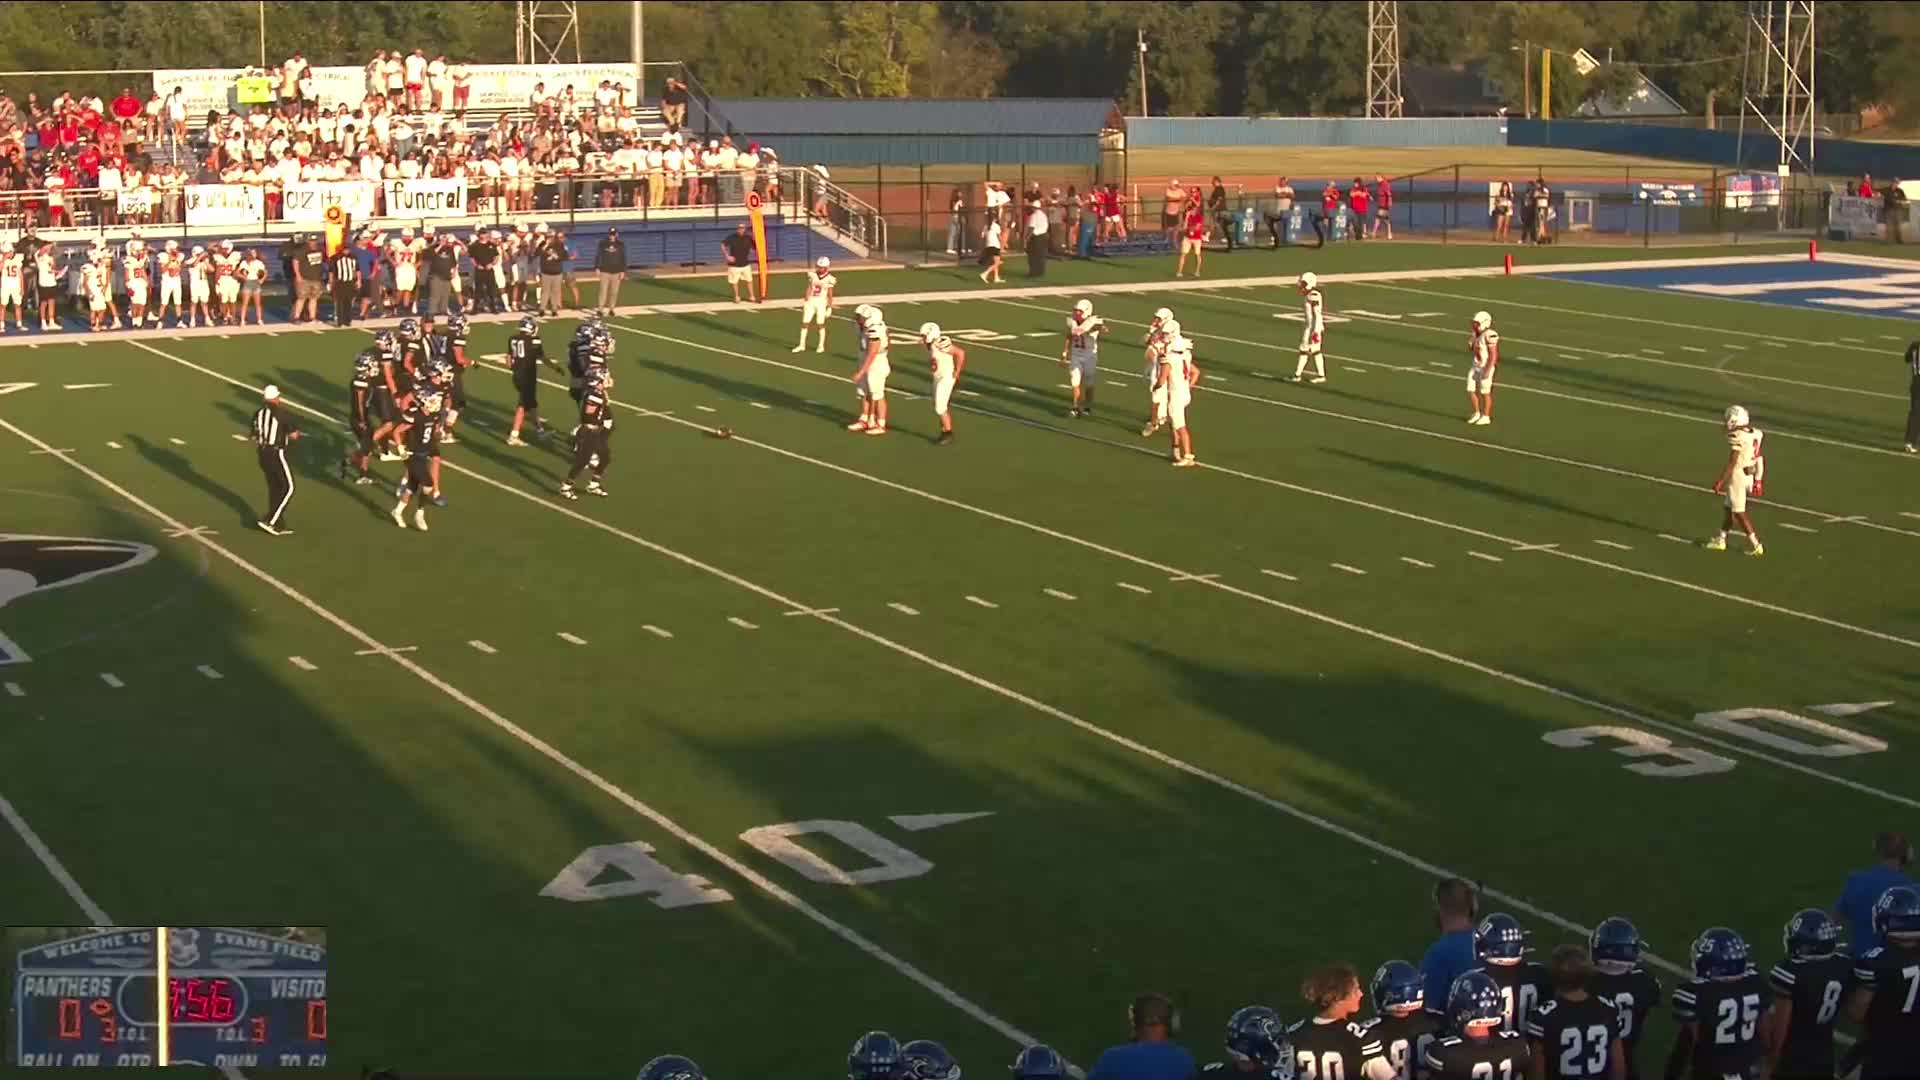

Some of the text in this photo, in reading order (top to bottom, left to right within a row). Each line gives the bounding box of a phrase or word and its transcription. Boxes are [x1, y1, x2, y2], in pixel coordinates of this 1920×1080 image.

[388, 181, 462, 211] funeral
[43, 932, 151, 960] WELCOME TO
[215, 932, 322, 962] EVANS FIELD
[24, 976, 114, 997] PANTHERS
[60, 998, 82, 1040] 0
[251, 1017, 266, 1043] 3
[1715, 994, 1761, 1044] 25
[1560, 1025, 1609, 1076] 23
